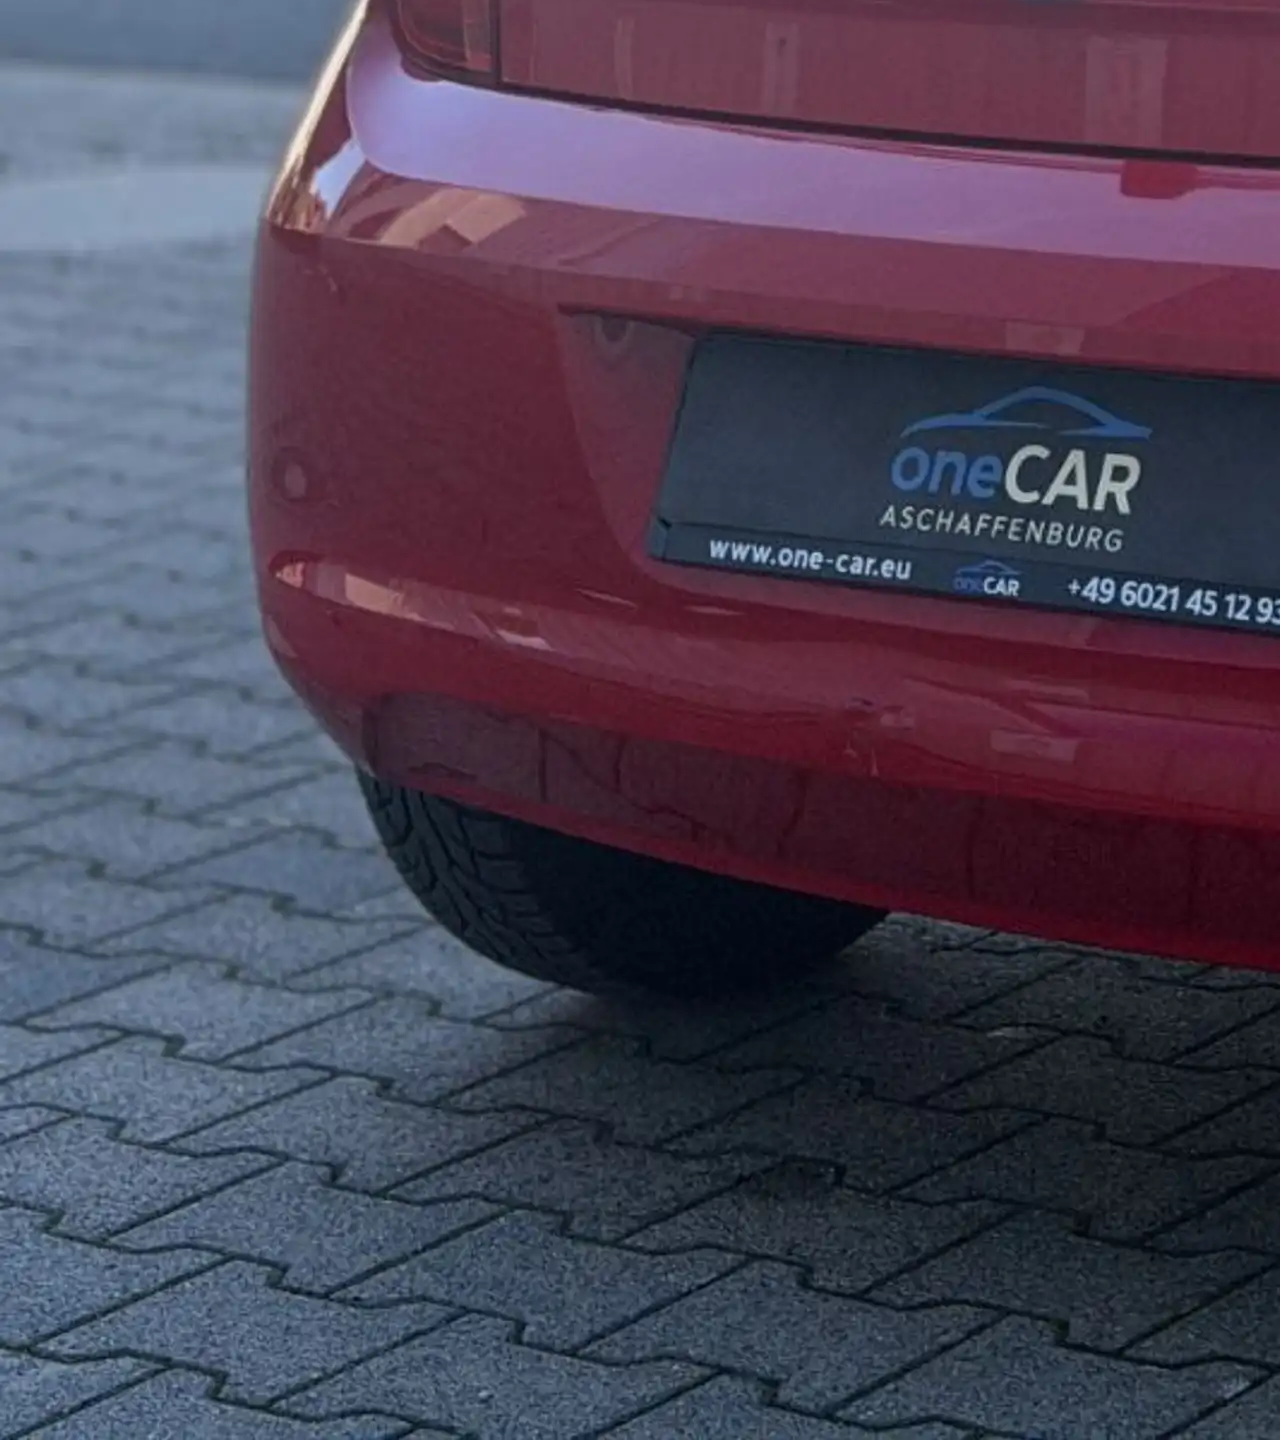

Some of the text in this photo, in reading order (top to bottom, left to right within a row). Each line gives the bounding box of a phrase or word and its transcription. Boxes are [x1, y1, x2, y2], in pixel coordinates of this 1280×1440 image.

[890, 444, 1143, 515] oneCAR
[879, 505, 1125, 552] ASCHAFFENBURG
[709, 539, 913, 581] www.one-car.eu
[1067, 575, 1116, 605] +49
[1120, 580, 1179, 612] 6021
[1184, 589, 1218, 617] 45
[1223, 592, 1251, 621] 12
